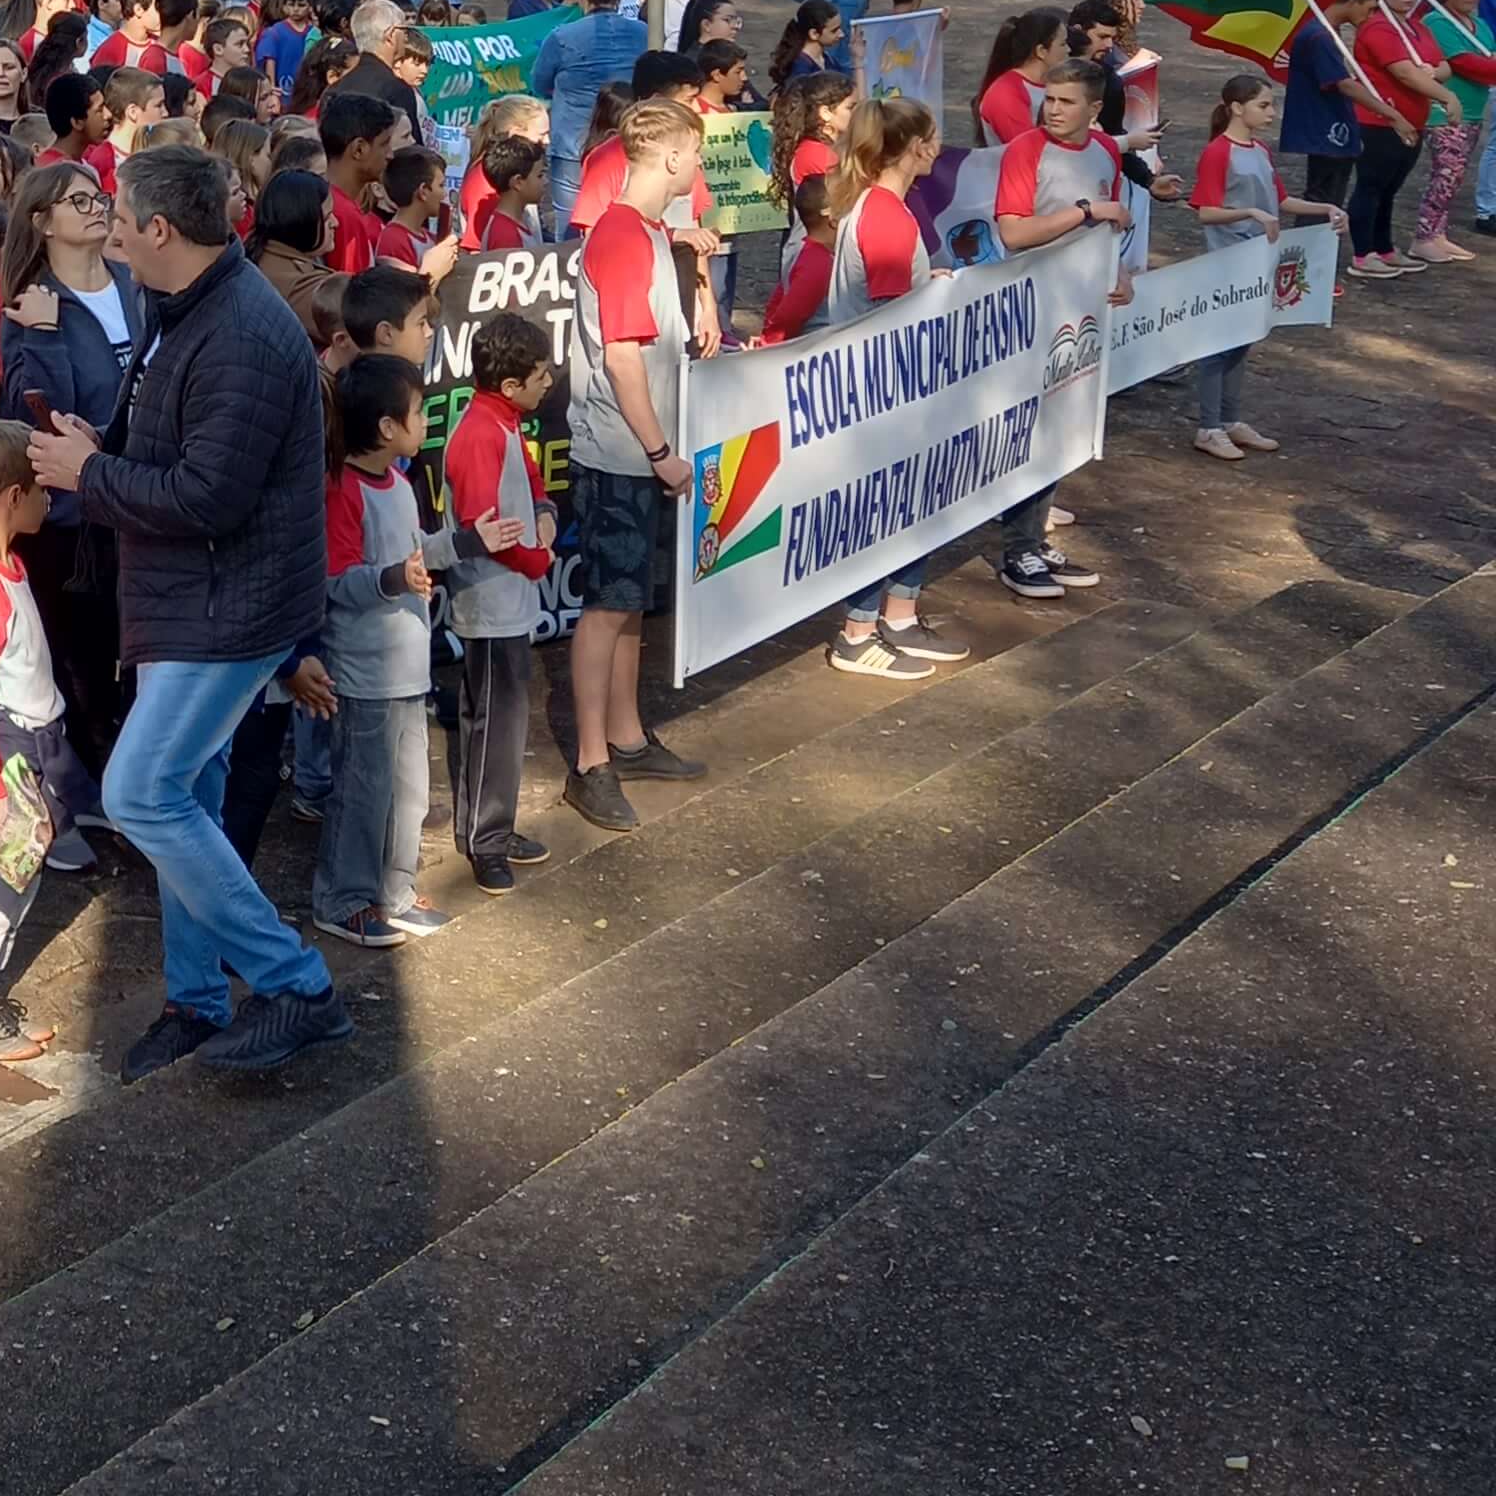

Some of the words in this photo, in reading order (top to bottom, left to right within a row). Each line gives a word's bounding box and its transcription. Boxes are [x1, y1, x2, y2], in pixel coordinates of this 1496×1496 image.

[473, 34, 522, 62] POR
[785, 345, 862, 449] ESCOLA
[863, 309, 959, 419] MUNICIPAL
[962, 300, 982, 380] DE
[982, 276, 1036, 369] ENSINO
[1133, 315, 1155, 340] São
[1157, 299, 1187, 333] José
[1190, 295, 1208, 318] do
[1212, 275, 1271, 311] Sobrado
[783, 453, 921, 588] FUNDAMENTAL
[916, 421, 986, 523] MARTIN
[979, 394, 1039, 489] LUTHER
